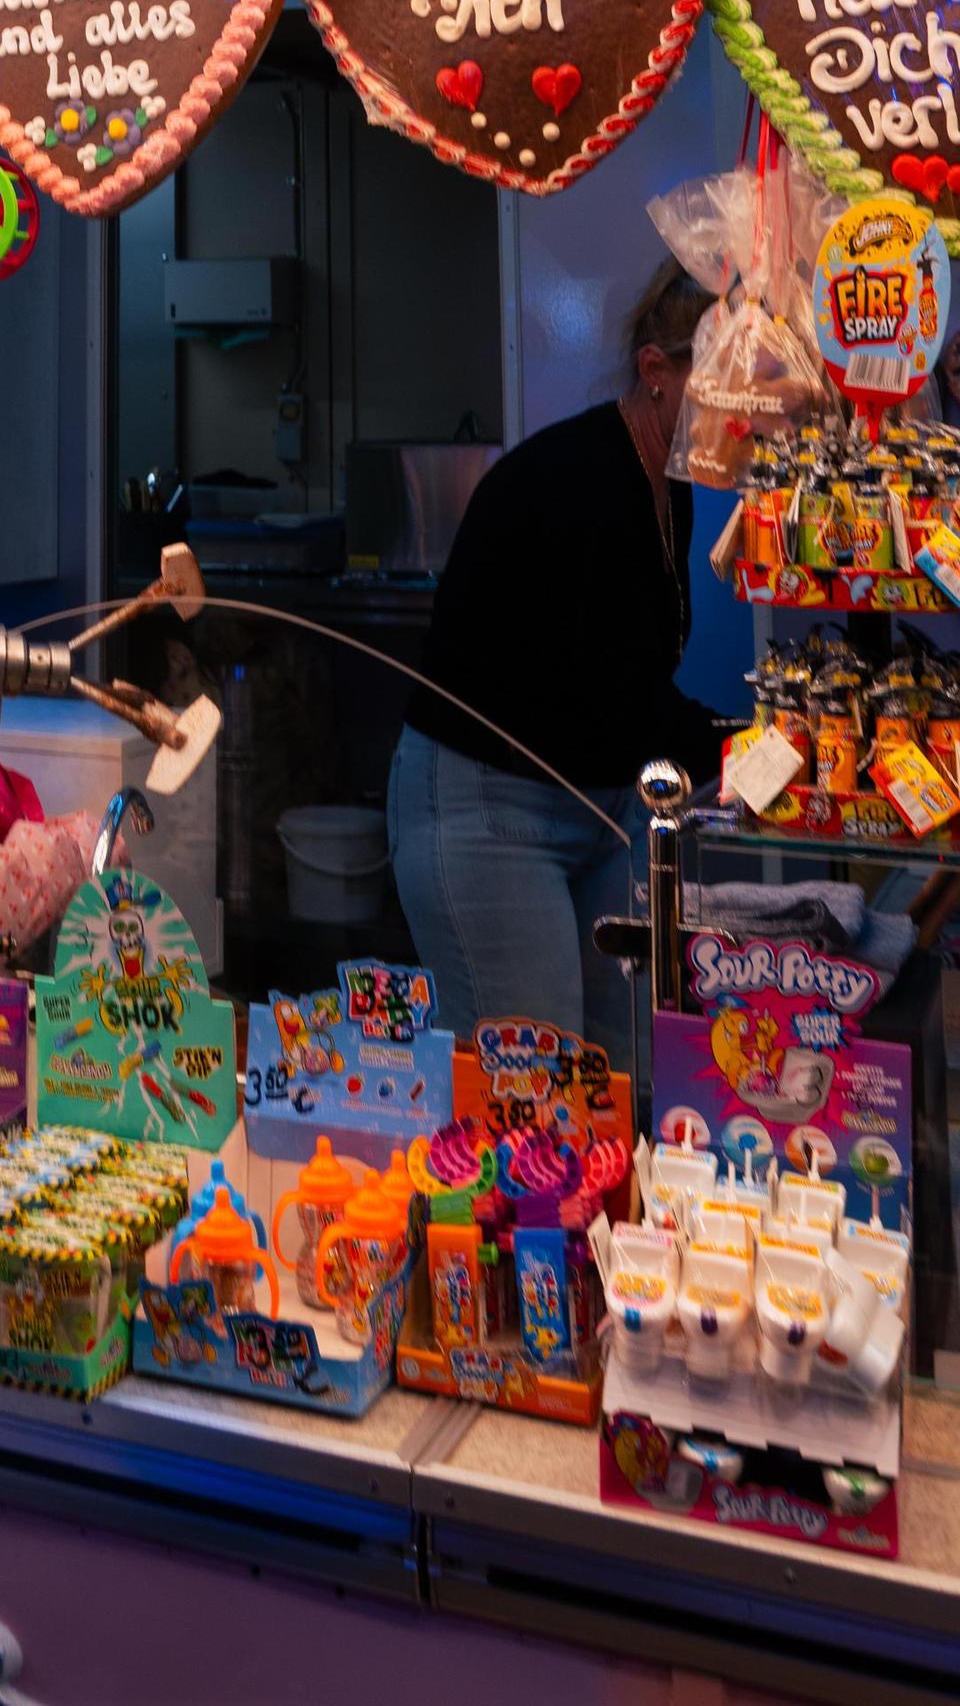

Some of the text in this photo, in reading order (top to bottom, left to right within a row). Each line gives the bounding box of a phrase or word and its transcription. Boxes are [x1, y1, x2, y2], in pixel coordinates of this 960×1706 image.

[46, 49, 159, 101] Liebe
[836, 268, 903, 322] FIRE
[844, 315, 900, 343] SPRAY
[106, 997, 182, 1038] SHOK
